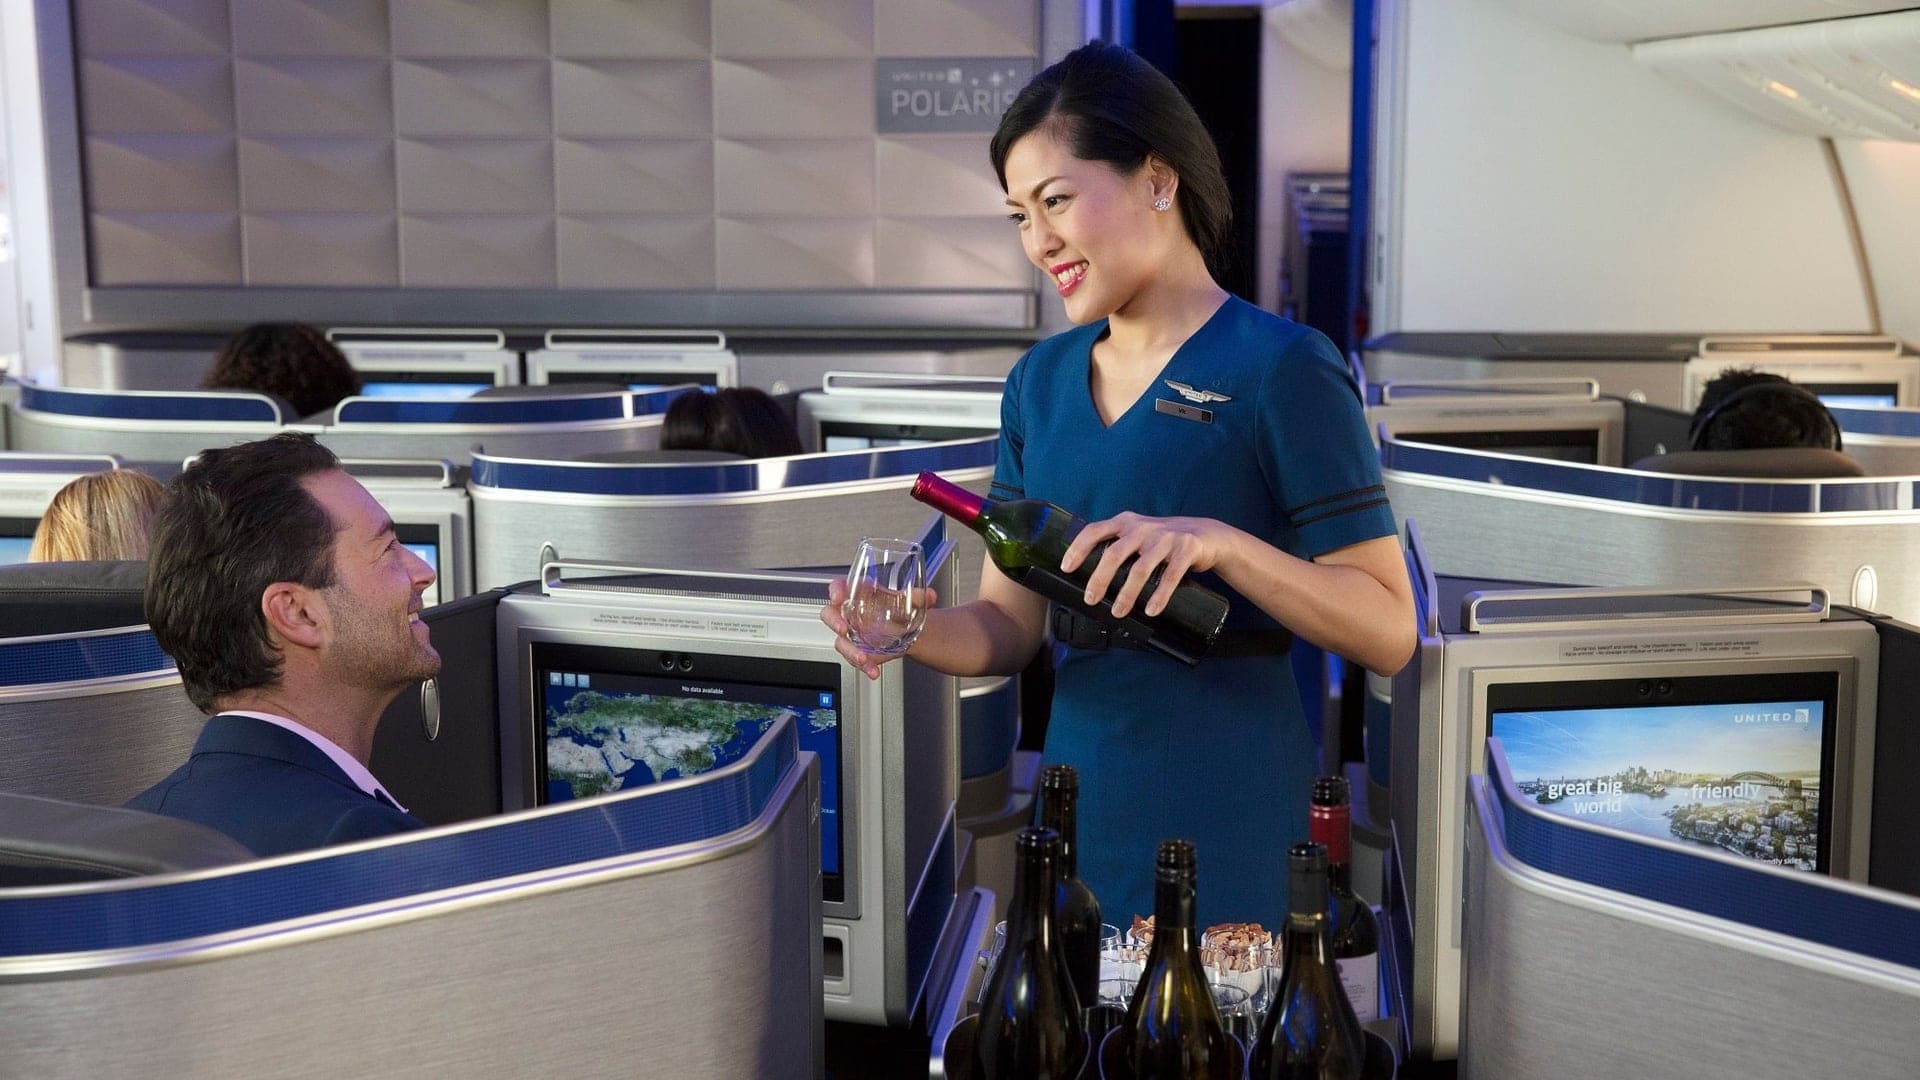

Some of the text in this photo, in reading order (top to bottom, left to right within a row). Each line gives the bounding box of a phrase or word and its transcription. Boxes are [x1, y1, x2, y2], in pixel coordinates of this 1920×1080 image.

[702, 687, 724, 695] available
[1734, 712, 1792, 723] UNITED
[1548, 778, 1623, 799] great big
[1692, 782, 1762, 800] friendly
[1573, 798, 1622, 814] world
